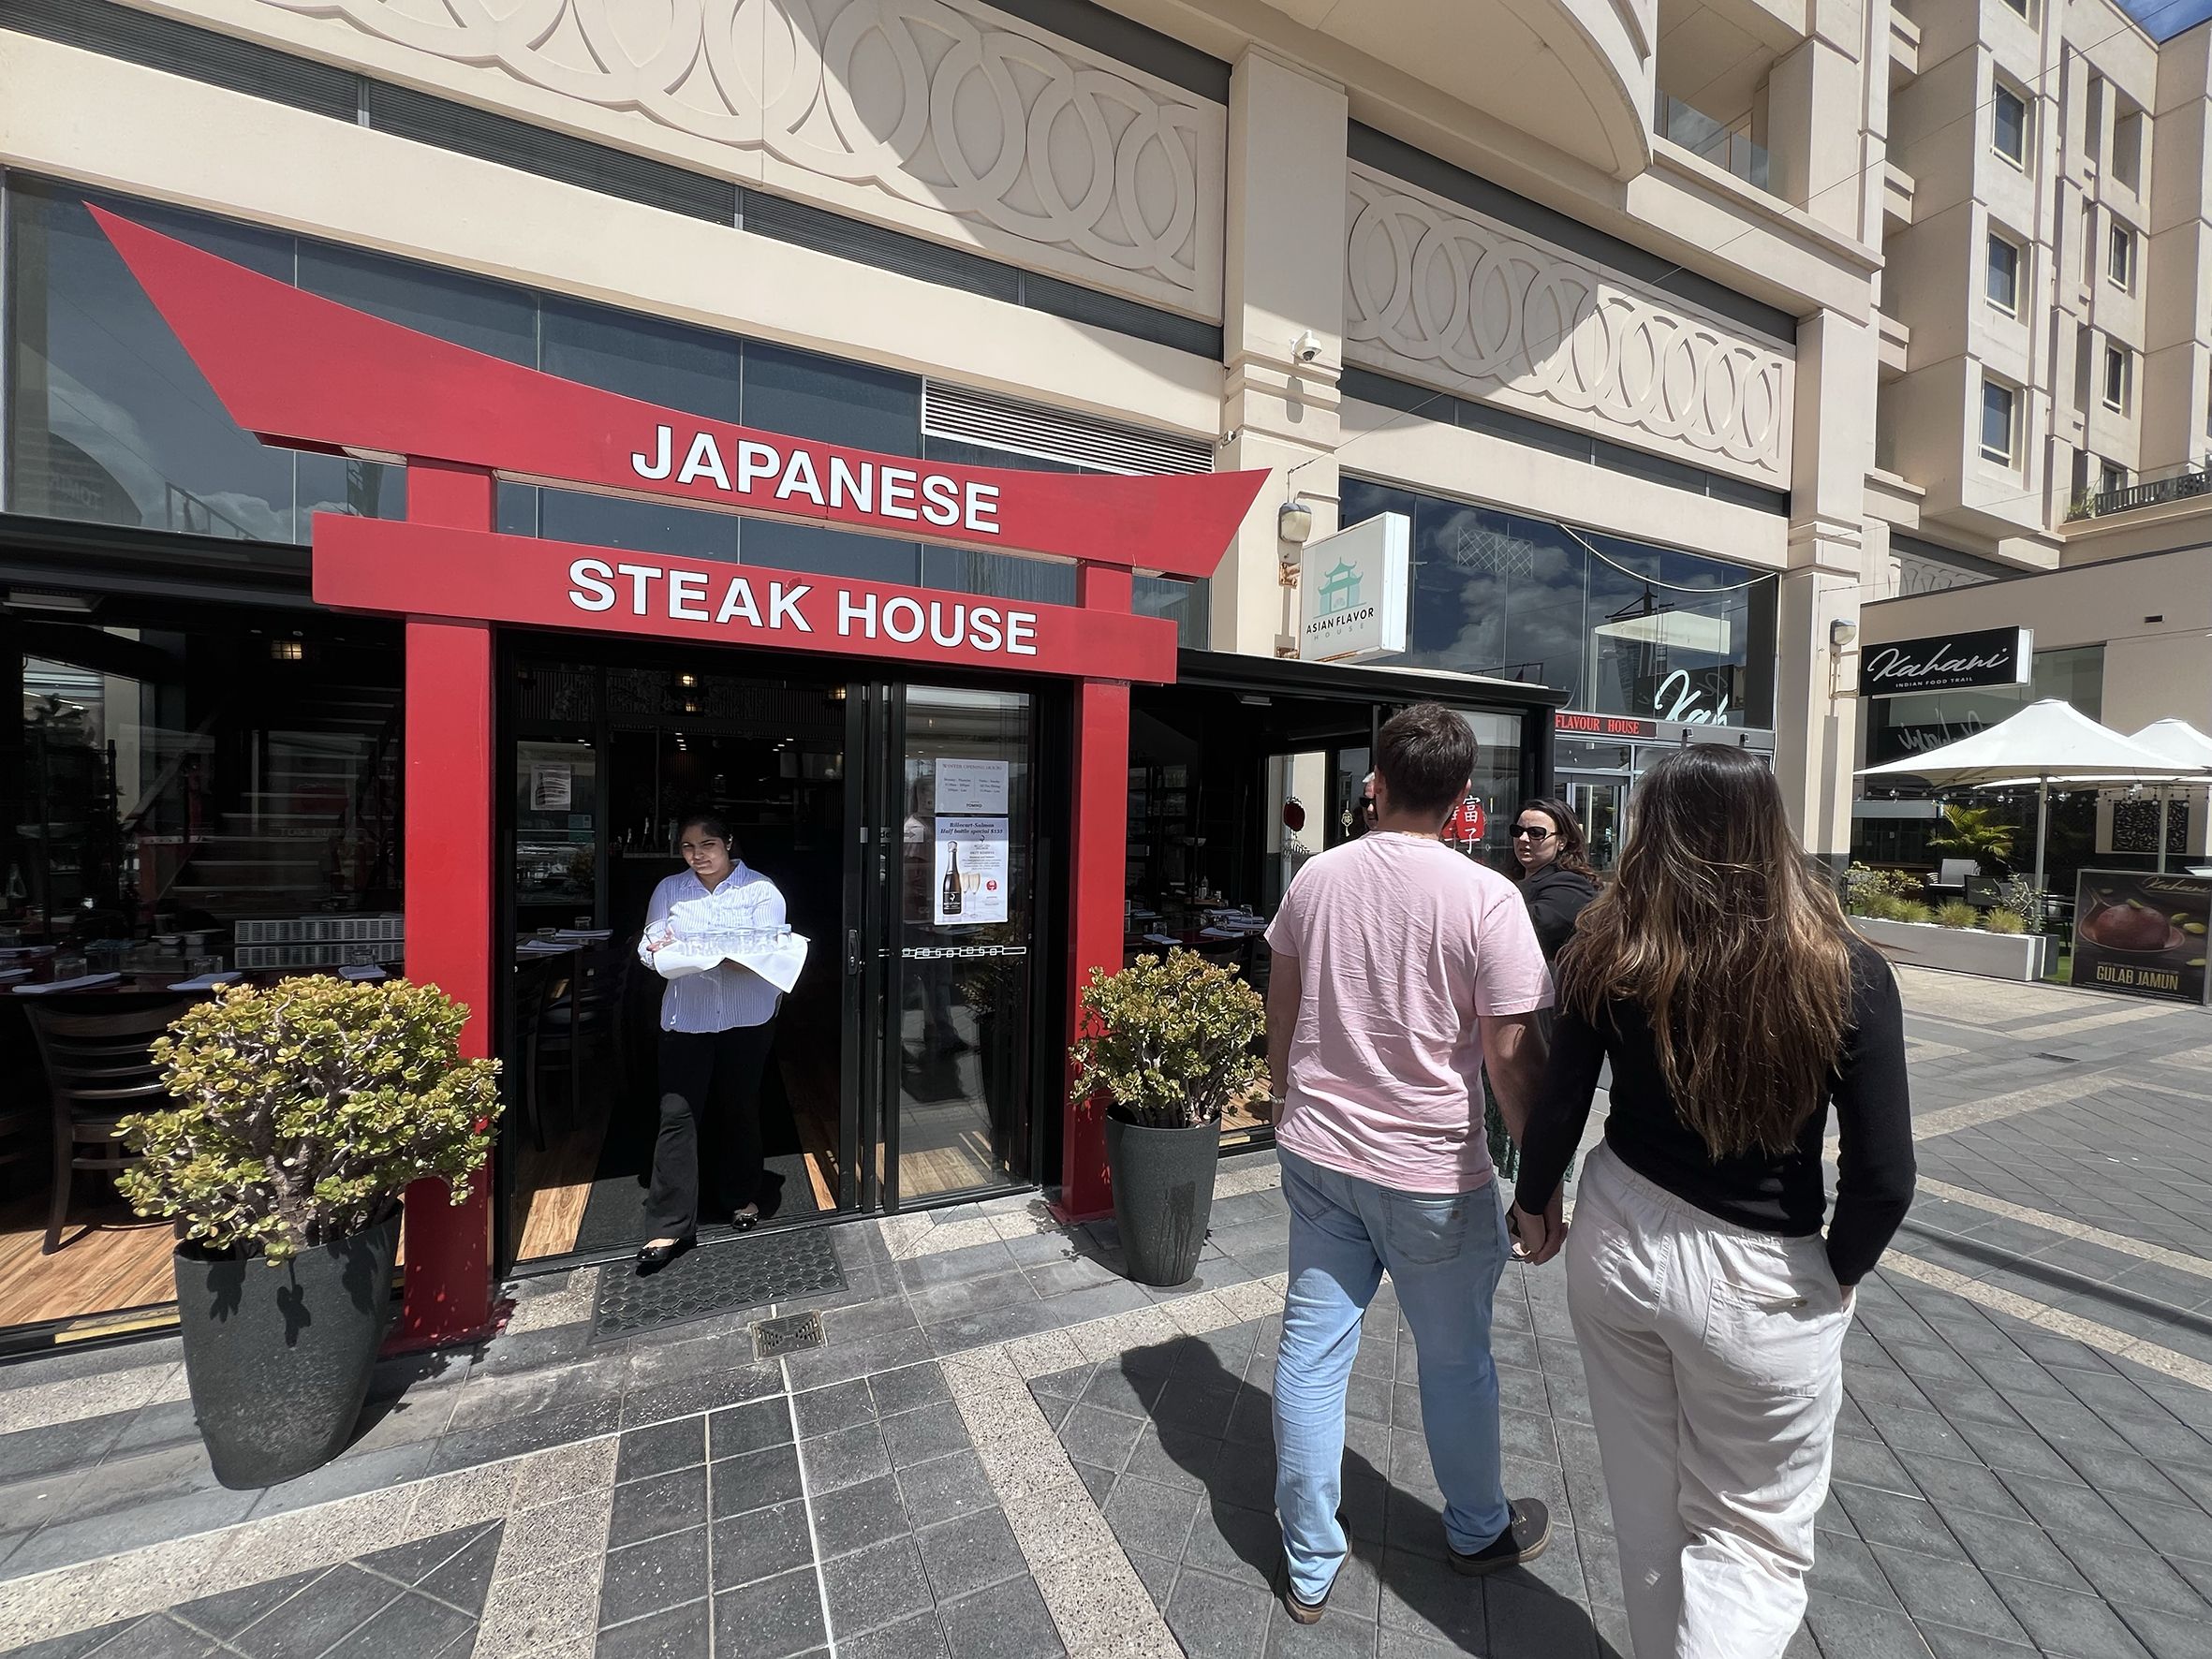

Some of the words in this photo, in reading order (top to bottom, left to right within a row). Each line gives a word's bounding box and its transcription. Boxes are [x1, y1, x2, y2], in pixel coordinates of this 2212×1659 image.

[631, 425, 1001, 535] JAPANESE
[568, 559, 814, 633] STEAK
[837, 590, 1038, 656] HOUSE
[1306, 618, 1334, 634] ASIAN
[1336, 608, 1374, 626] FLAVOR
[1314, 623, 1364, 640] HOUSE
[1867, 643, 2010, 683] Kahani
[1555, 714, 1600, 731] FLAVOUR
[1607, 719, 1640, 735] HOUSE
[2096, 965, 2134, 984] GULAB
[2136, 971, 2179, 991] JAMUN
